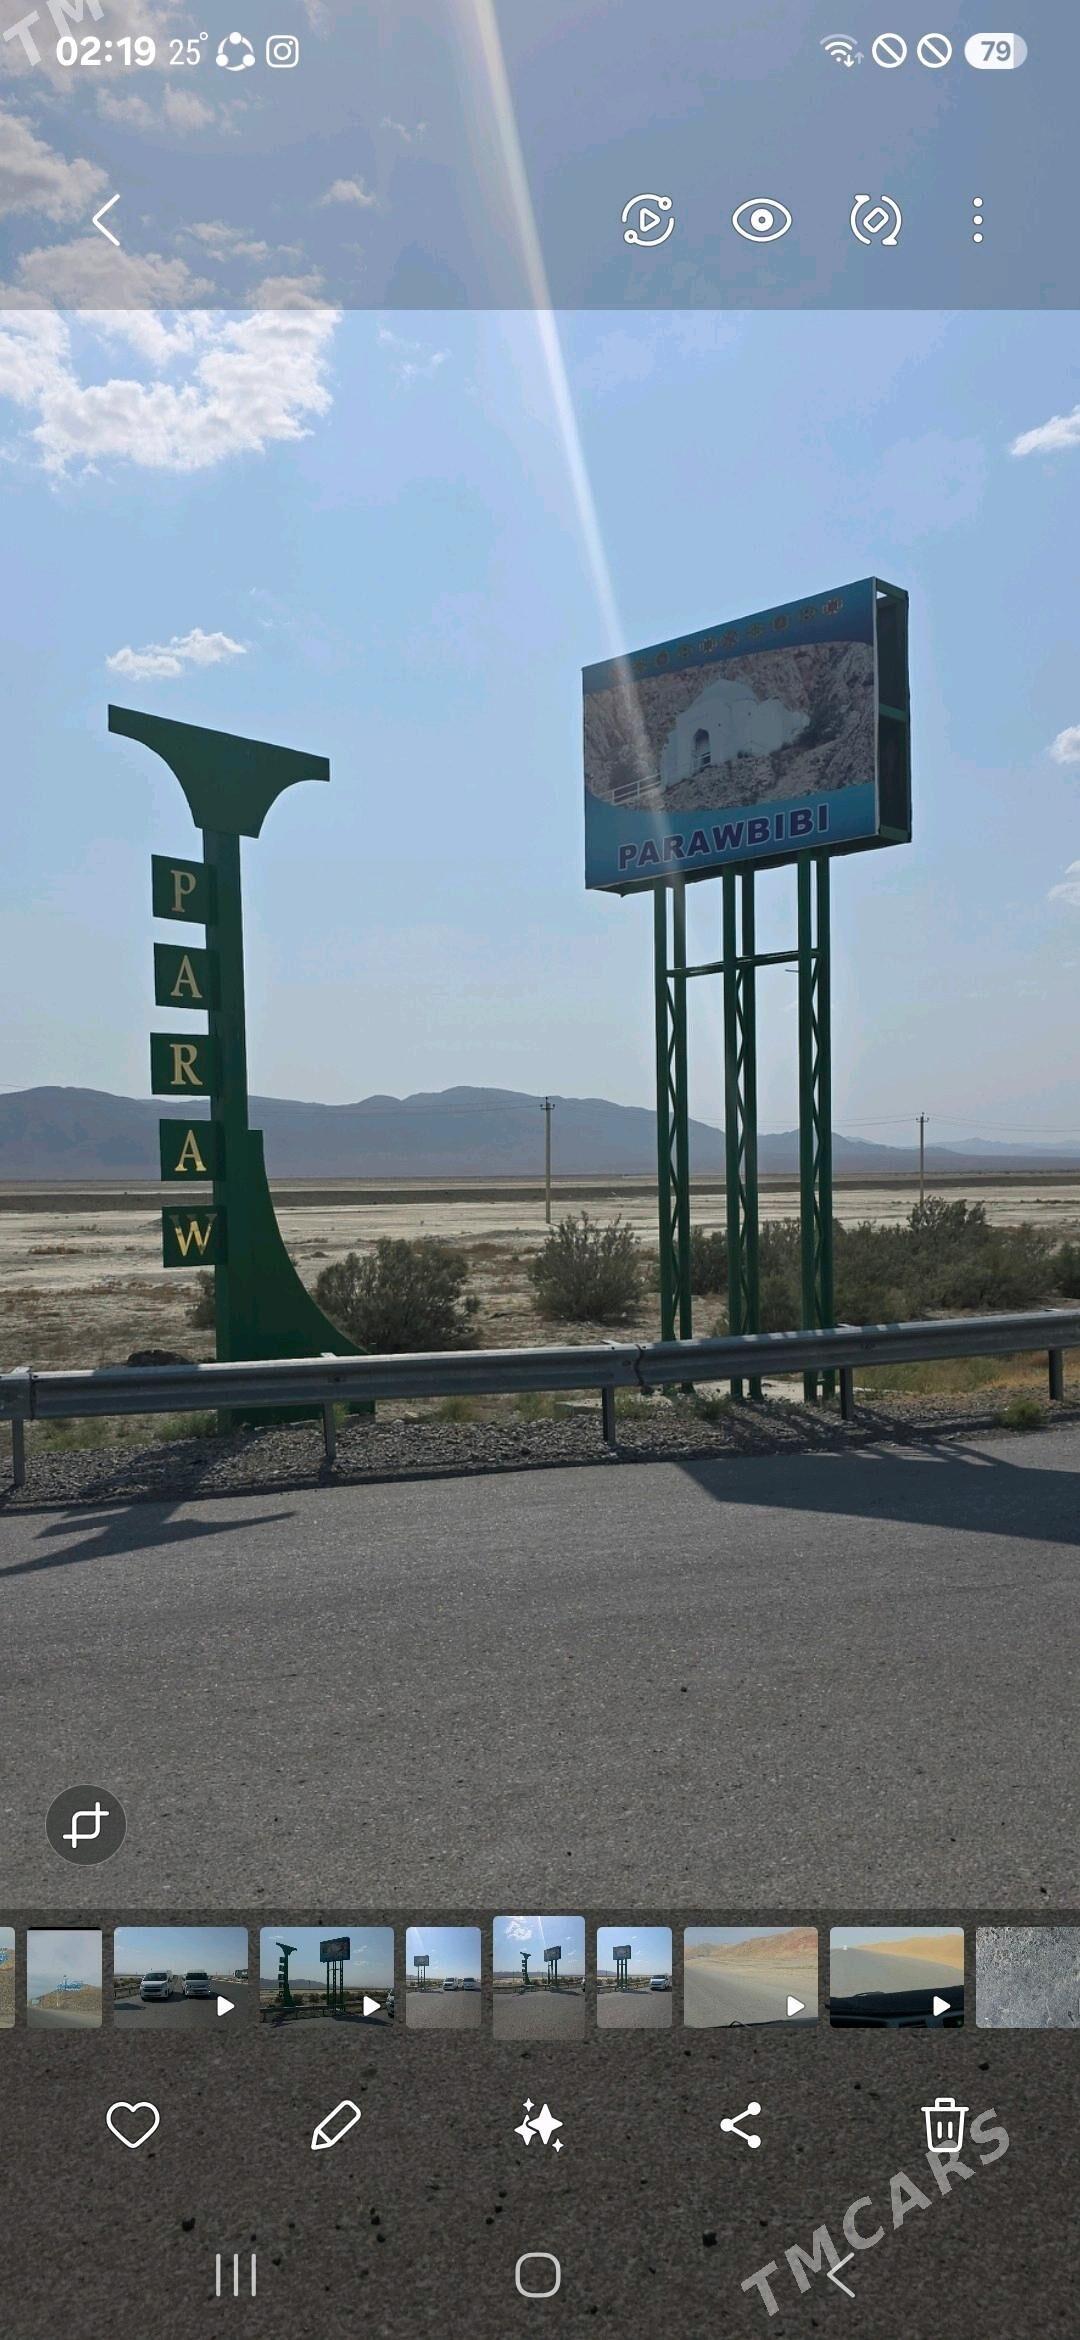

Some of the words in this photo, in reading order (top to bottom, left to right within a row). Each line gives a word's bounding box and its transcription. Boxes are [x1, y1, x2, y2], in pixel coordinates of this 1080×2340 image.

[56, 35, 156, 67] 02:19
[980, 40, 1011, 61] 79
[617, 803, 831, 872] PARAWBIBI
[169, 869, 218, 1257] PARAW
